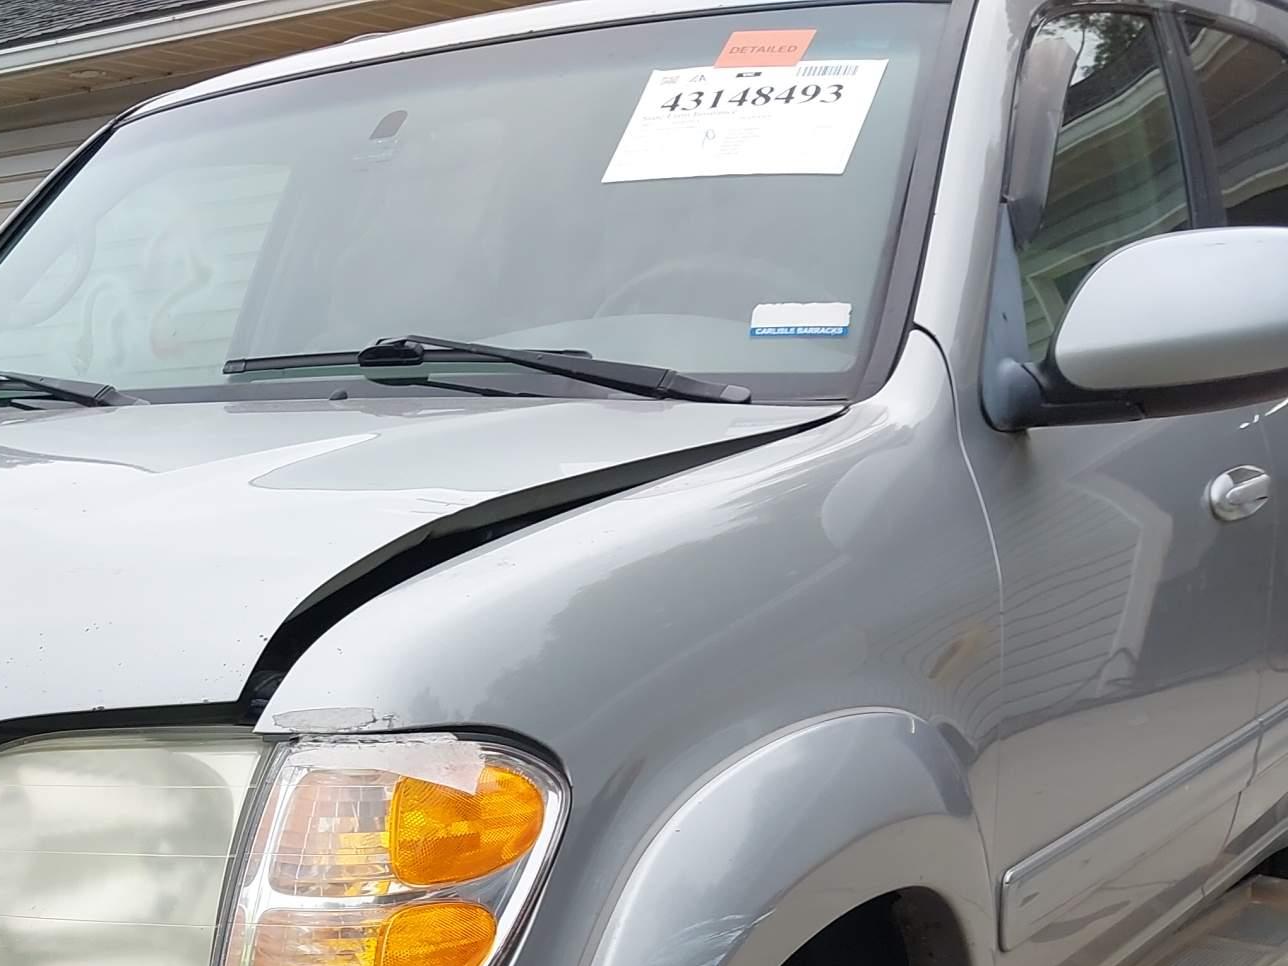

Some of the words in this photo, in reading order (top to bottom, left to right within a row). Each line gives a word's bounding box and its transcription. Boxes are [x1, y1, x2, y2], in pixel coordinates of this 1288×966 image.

[728, 45, 798, 54] DETAILED
[661, 84, 844, 112] 43148493
[755, 327, 795, 335] CARLISLE
[796, 327, 843, 335] BARRACKS
